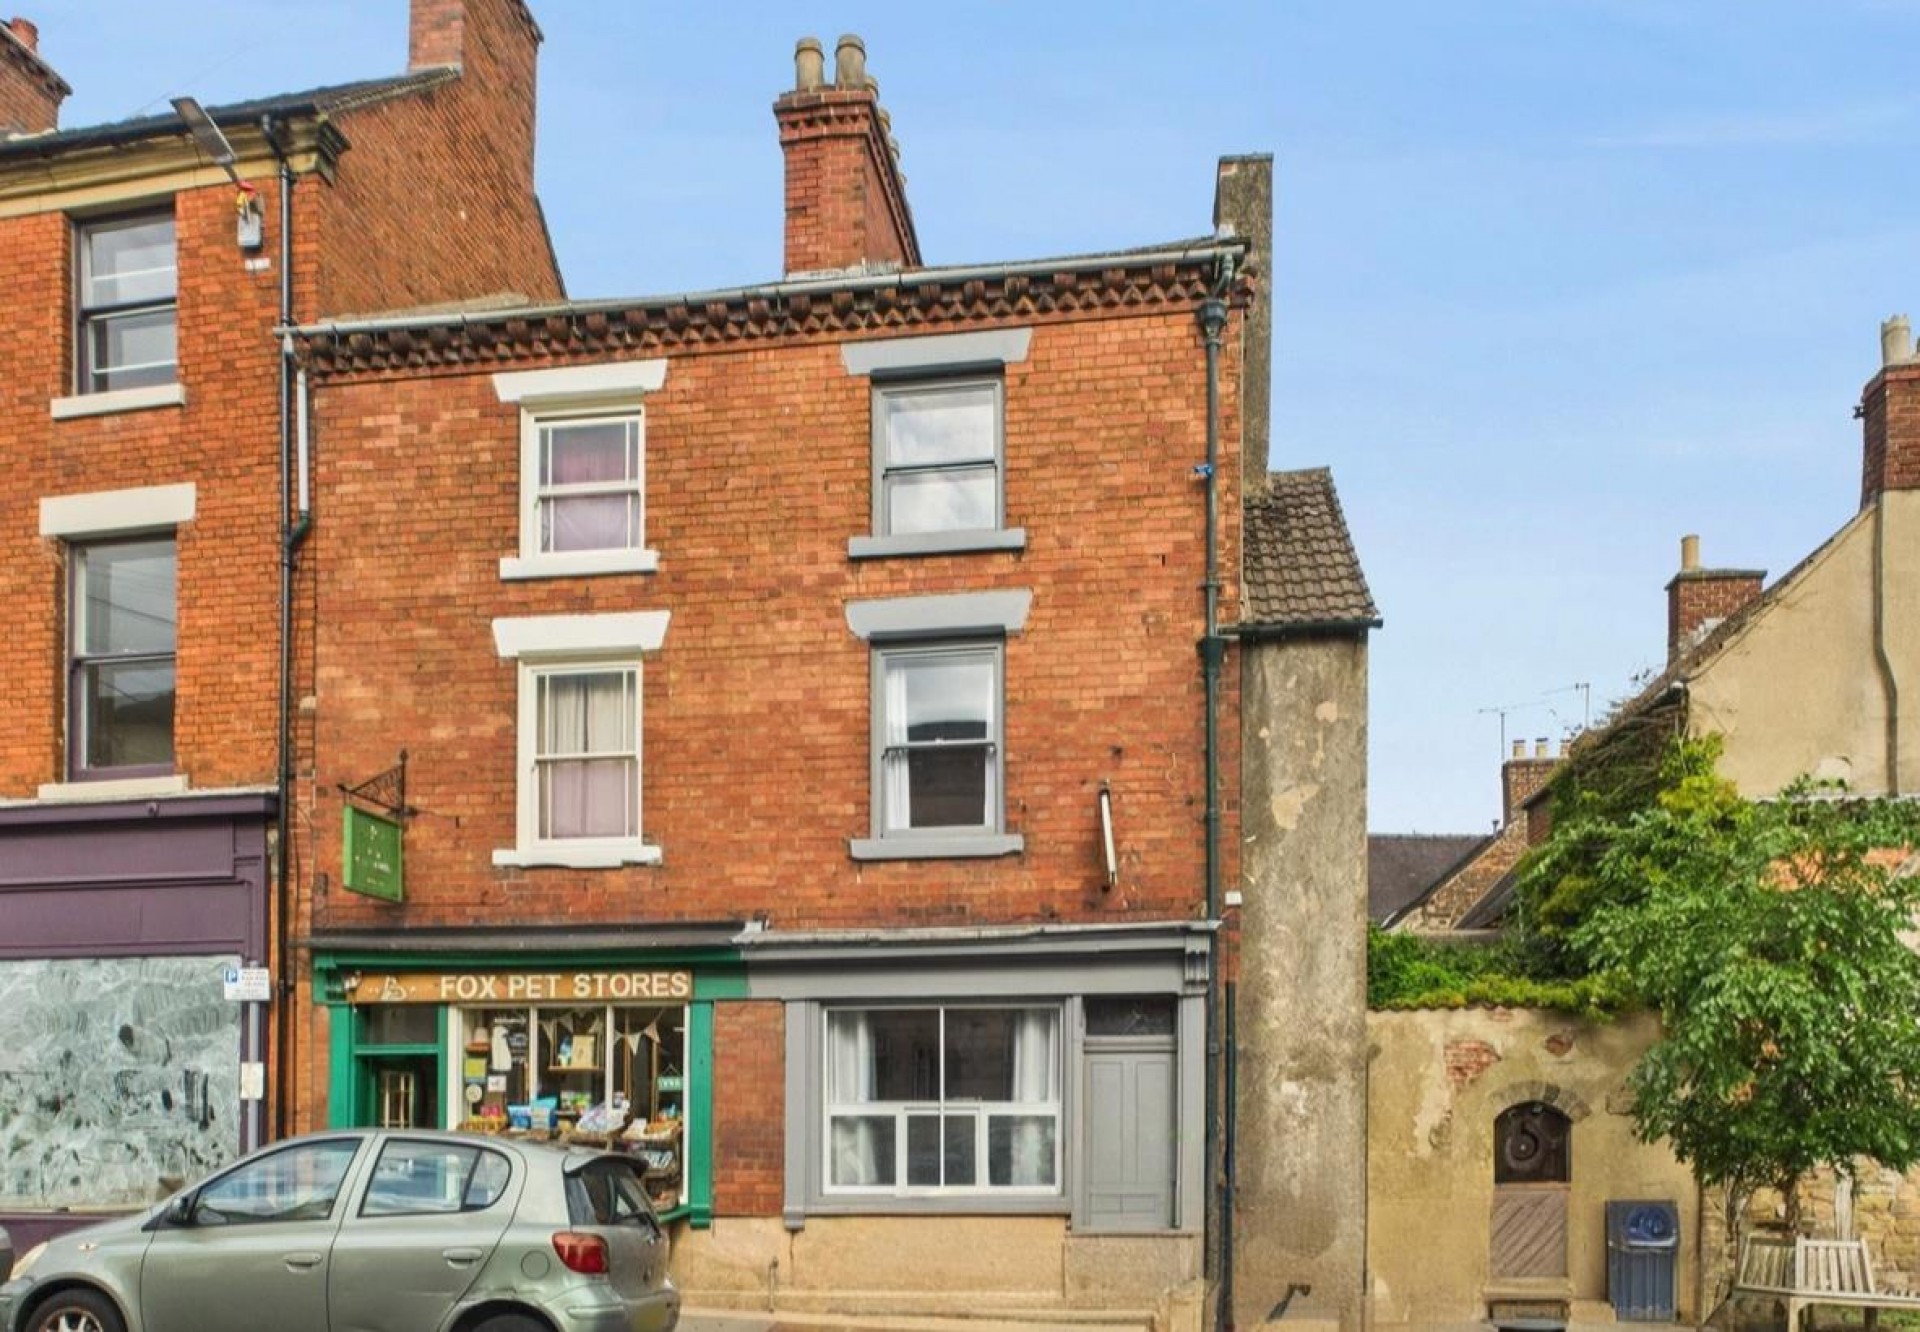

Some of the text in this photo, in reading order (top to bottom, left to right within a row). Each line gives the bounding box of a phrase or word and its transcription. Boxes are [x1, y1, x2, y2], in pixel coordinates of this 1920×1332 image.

[440, 973, 689, 999] FOX PET STORES
